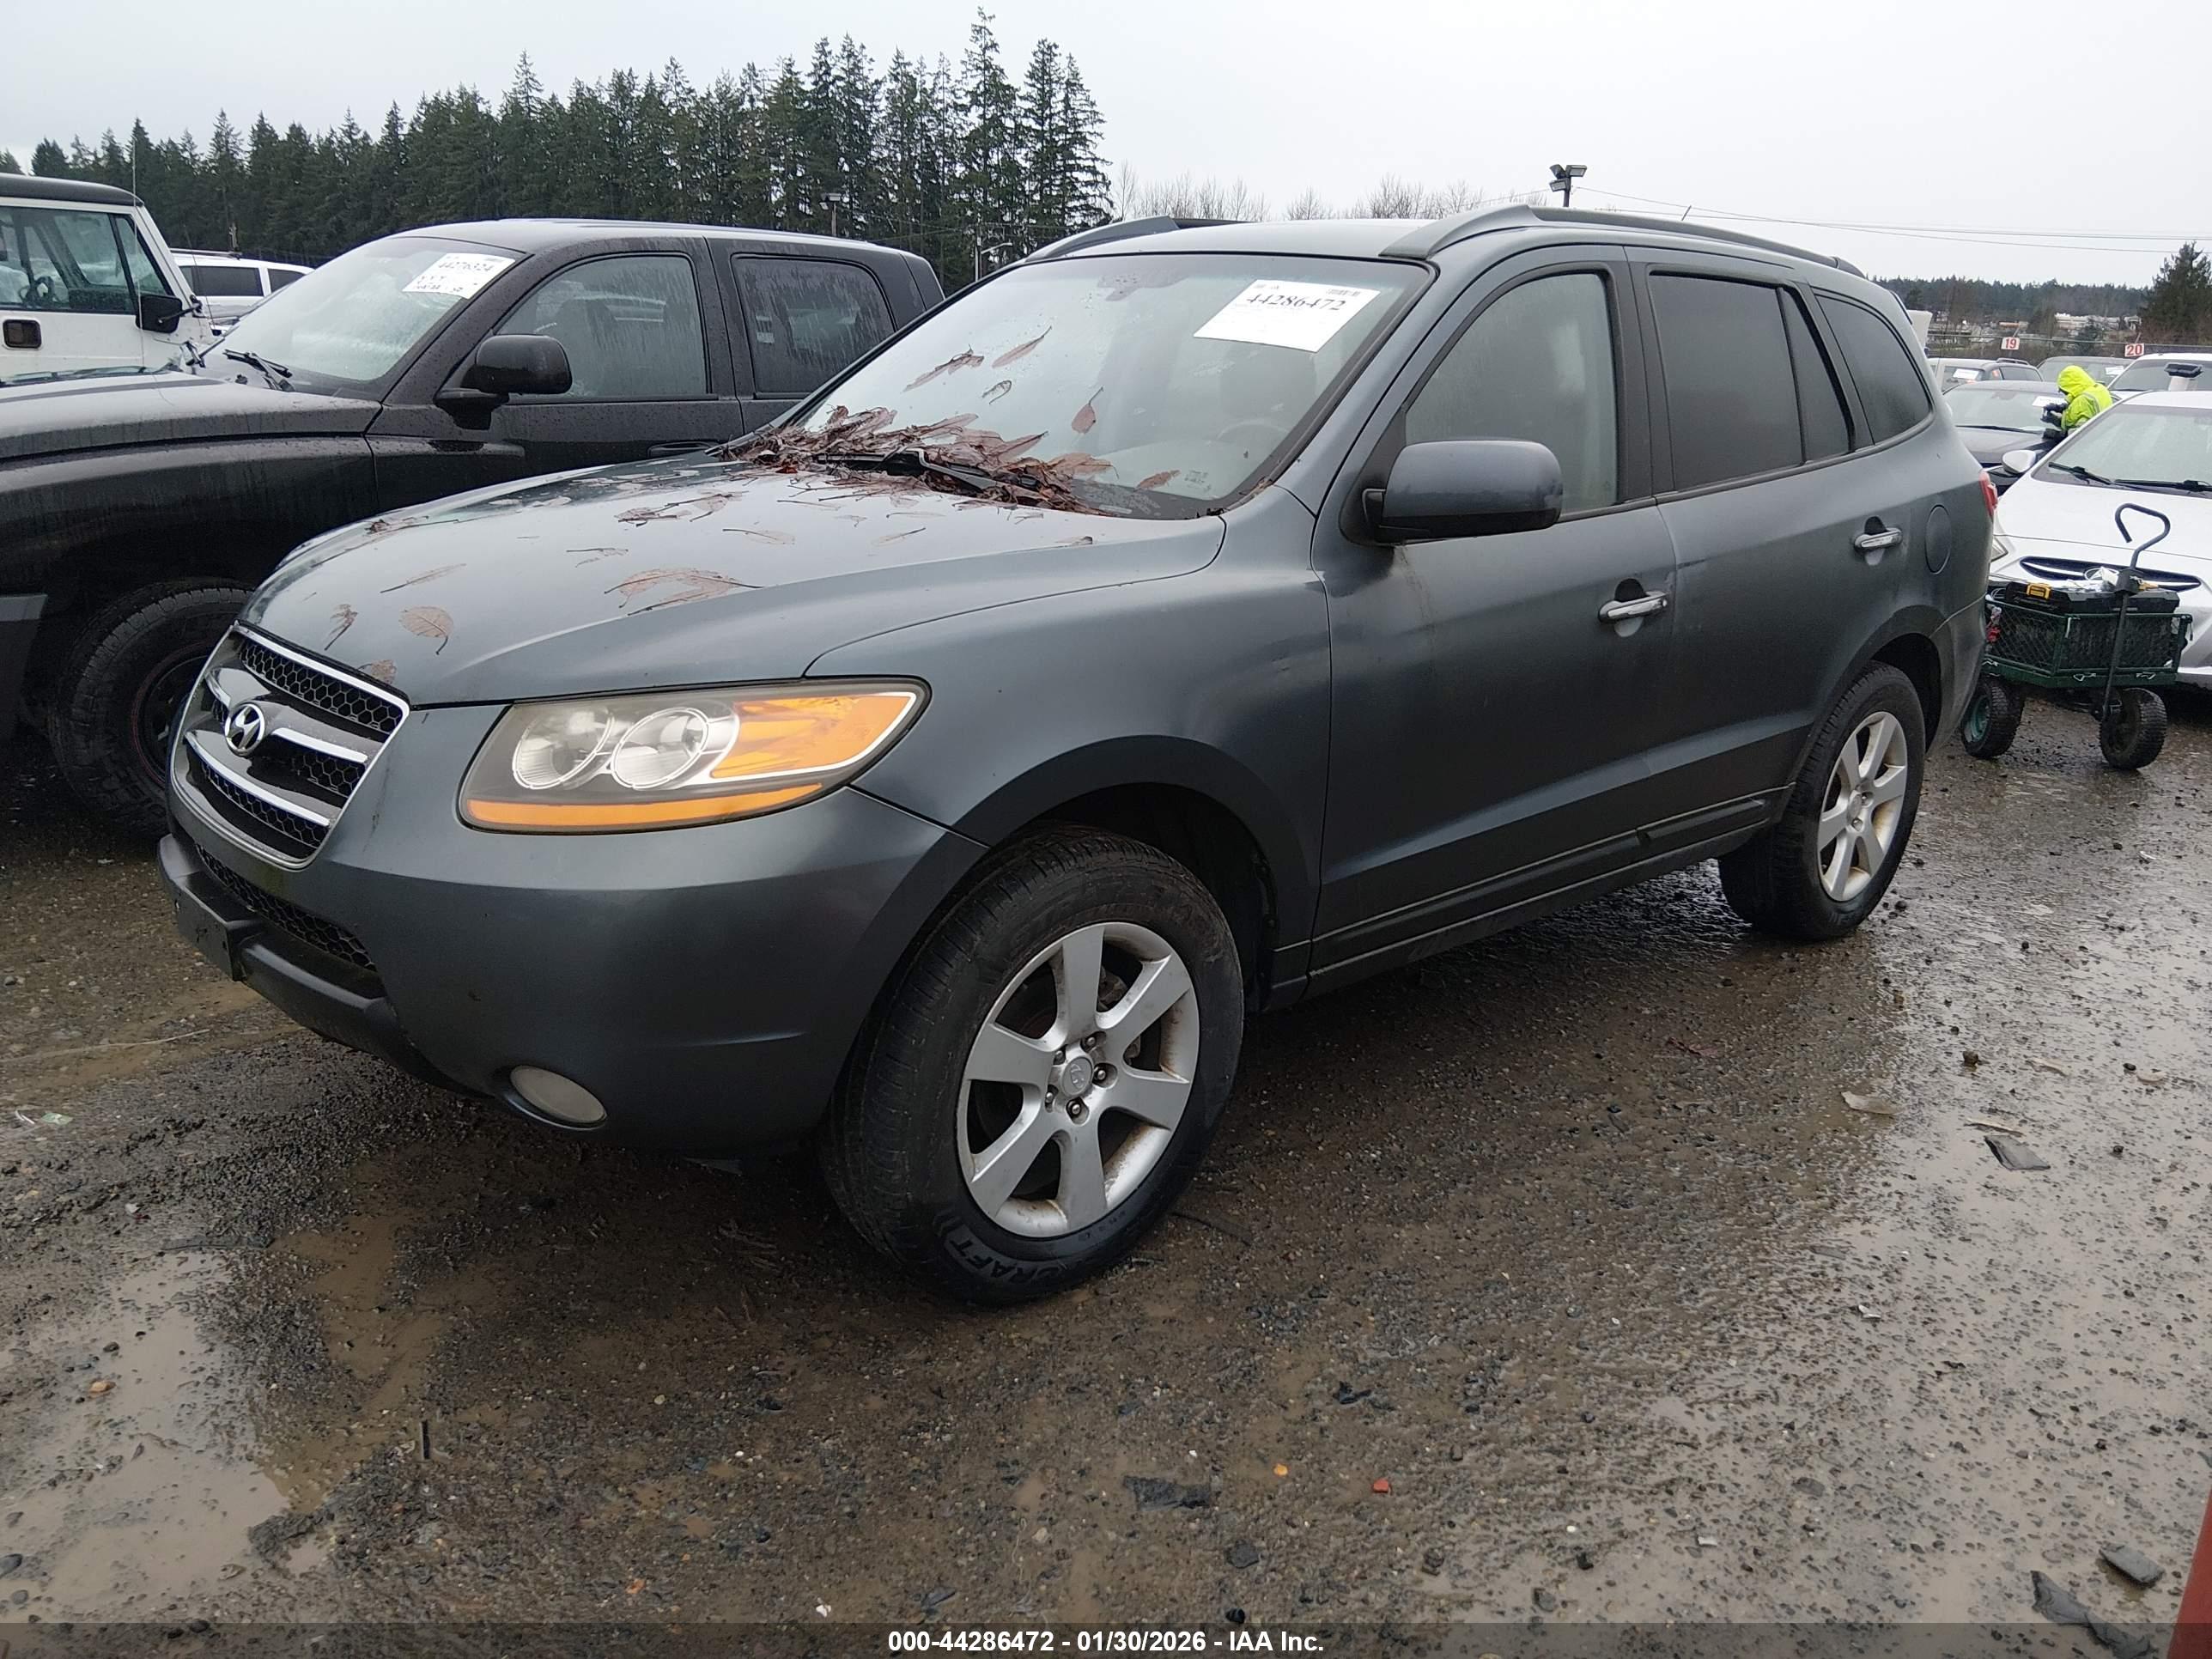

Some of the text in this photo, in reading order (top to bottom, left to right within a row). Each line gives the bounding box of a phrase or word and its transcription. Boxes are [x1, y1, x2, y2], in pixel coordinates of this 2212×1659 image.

[1247, 293, 1346, 311] 44286472
[2005, 338, 2016, 349] 19
[2126, 345, 2142, 356] 20
